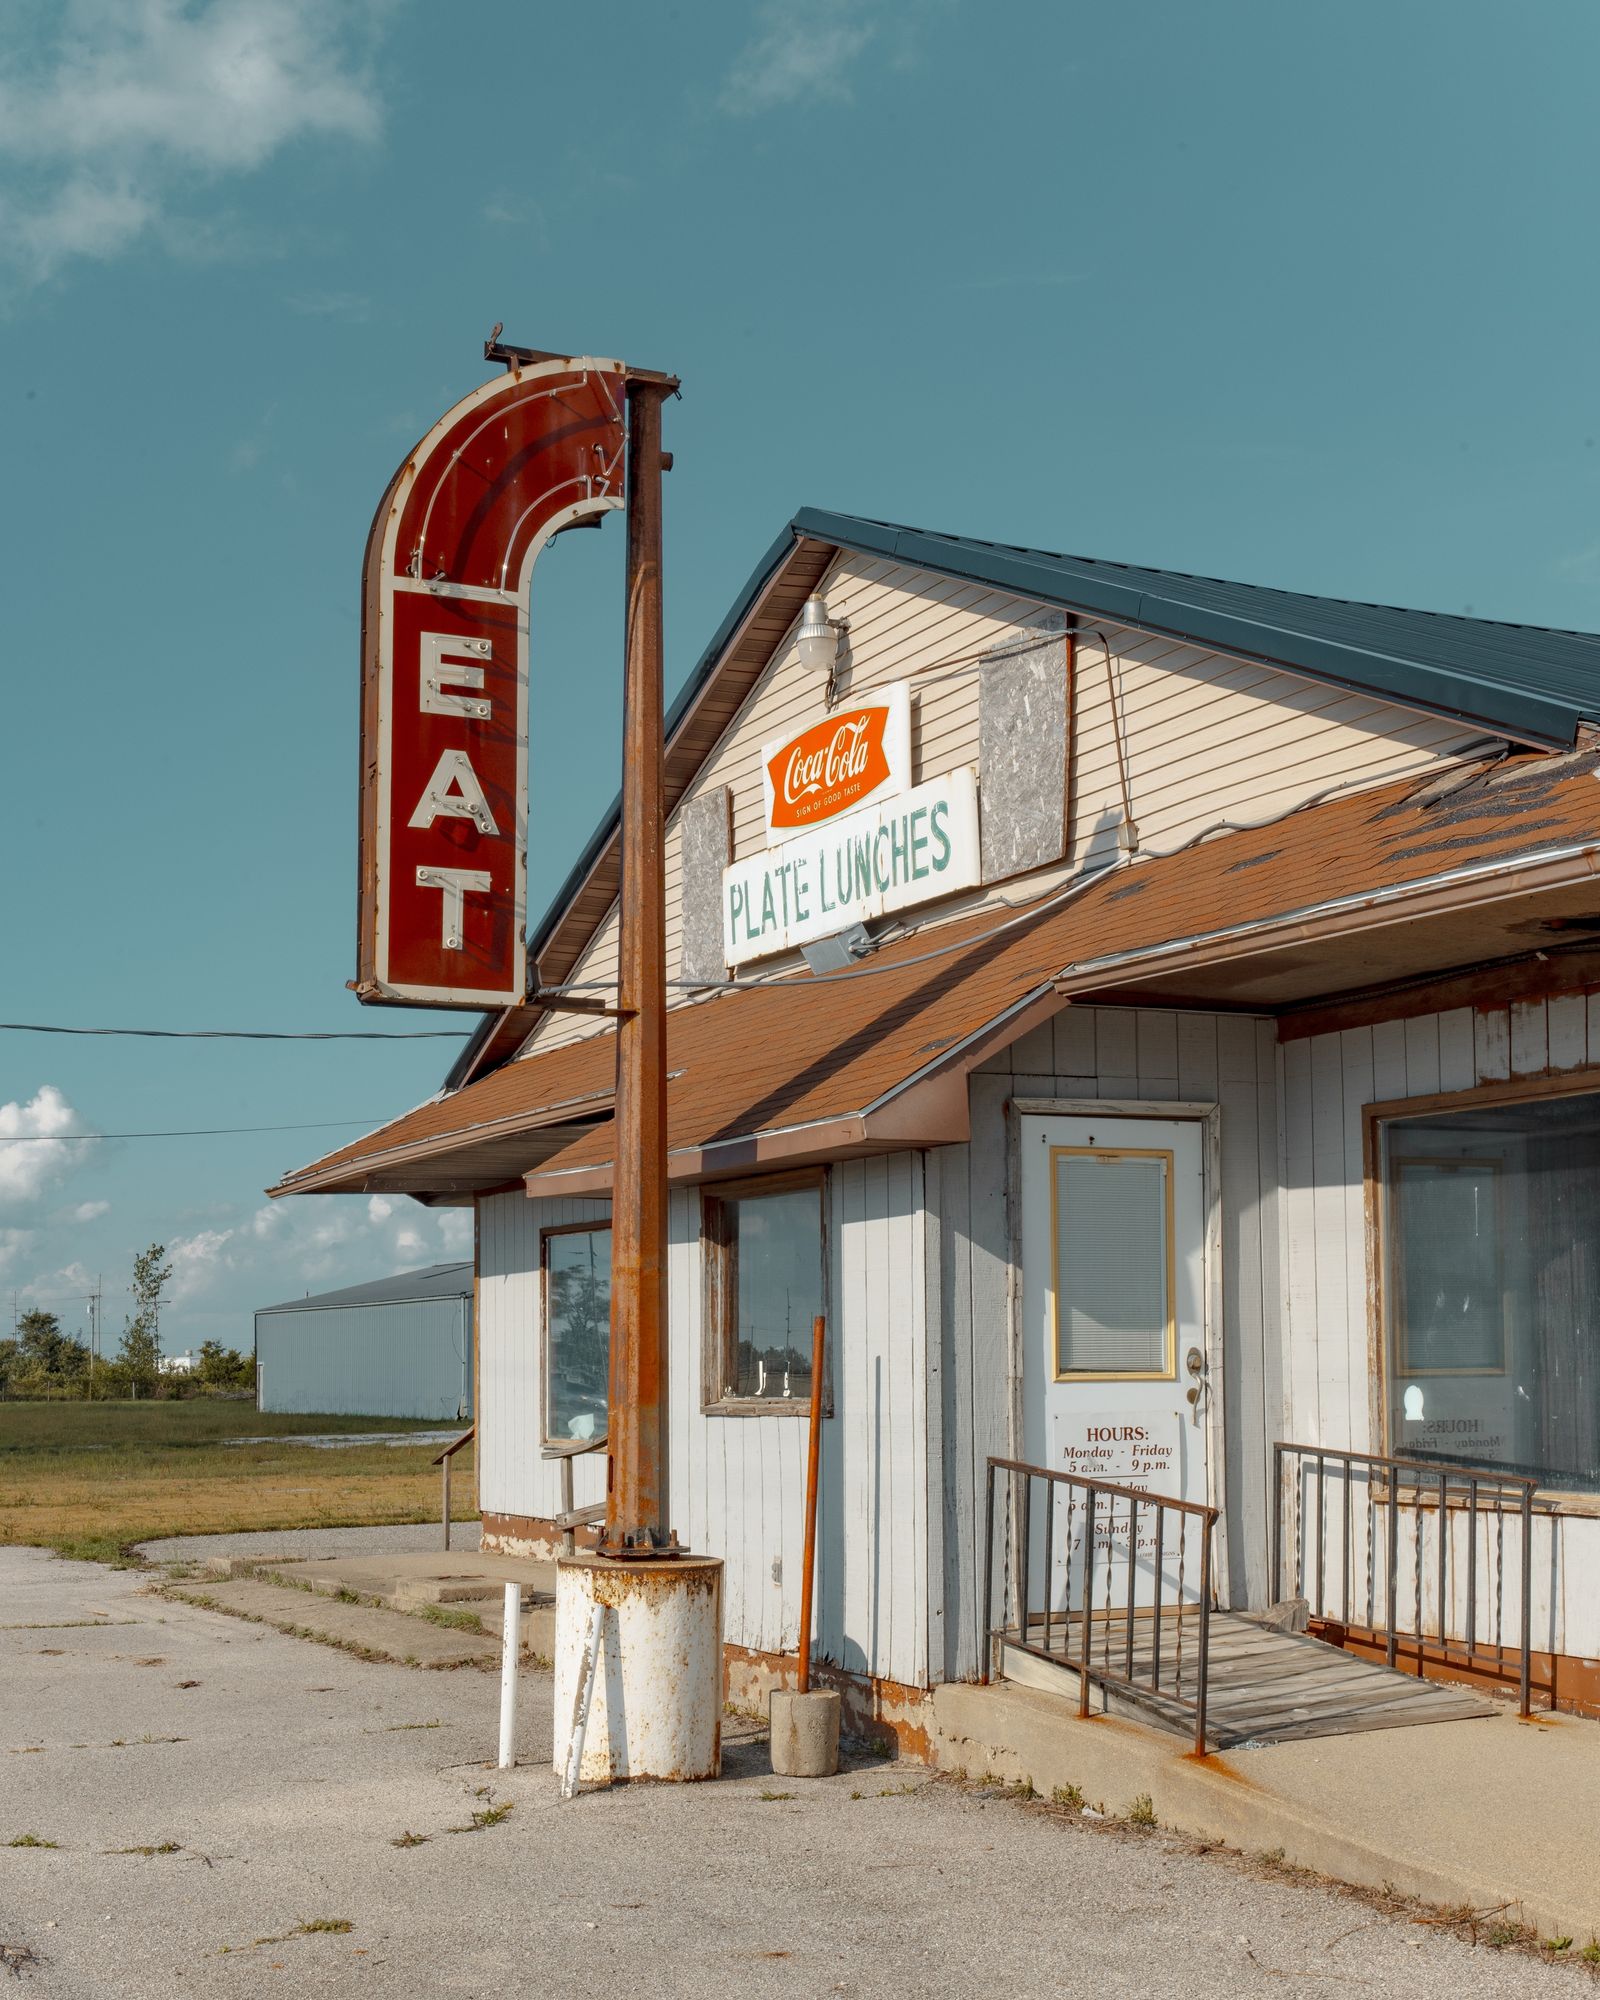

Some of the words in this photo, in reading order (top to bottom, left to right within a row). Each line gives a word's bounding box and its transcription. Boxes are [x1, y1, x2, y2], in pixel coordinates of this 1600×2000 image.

[784, 712, 871, 805] Coca-Cola
[407, 631, 500, 951] EAT
[796, 805, 811, 818] SIGN
[813, 800, 821, 811] OF
[823, 792, 842, 806] GOOD
[844, 782, 861, 797] TASTE
[729, 858, 810, 945] PLATE
[819, 800, 952, 913] LUNCHES
[1087, 1426, 1149, 1442] HOURS:
[1063, 1446, 1114, 1460] Monday
[1132, 1444, 1173, 1458] Friday
[1069, 1460, 1077, 1473] 5
[1081, 1463, 1108, 1473] a.m.
[1131, 1459, 1139, 1471] 9
[1143, 1461, 1171, 1473] p.m.
[1081, 1500, 1108, 1511] am.
[1095, 1522, 1144, 1535] Sundy
[1074, 1539, 1081, 1550] 7
